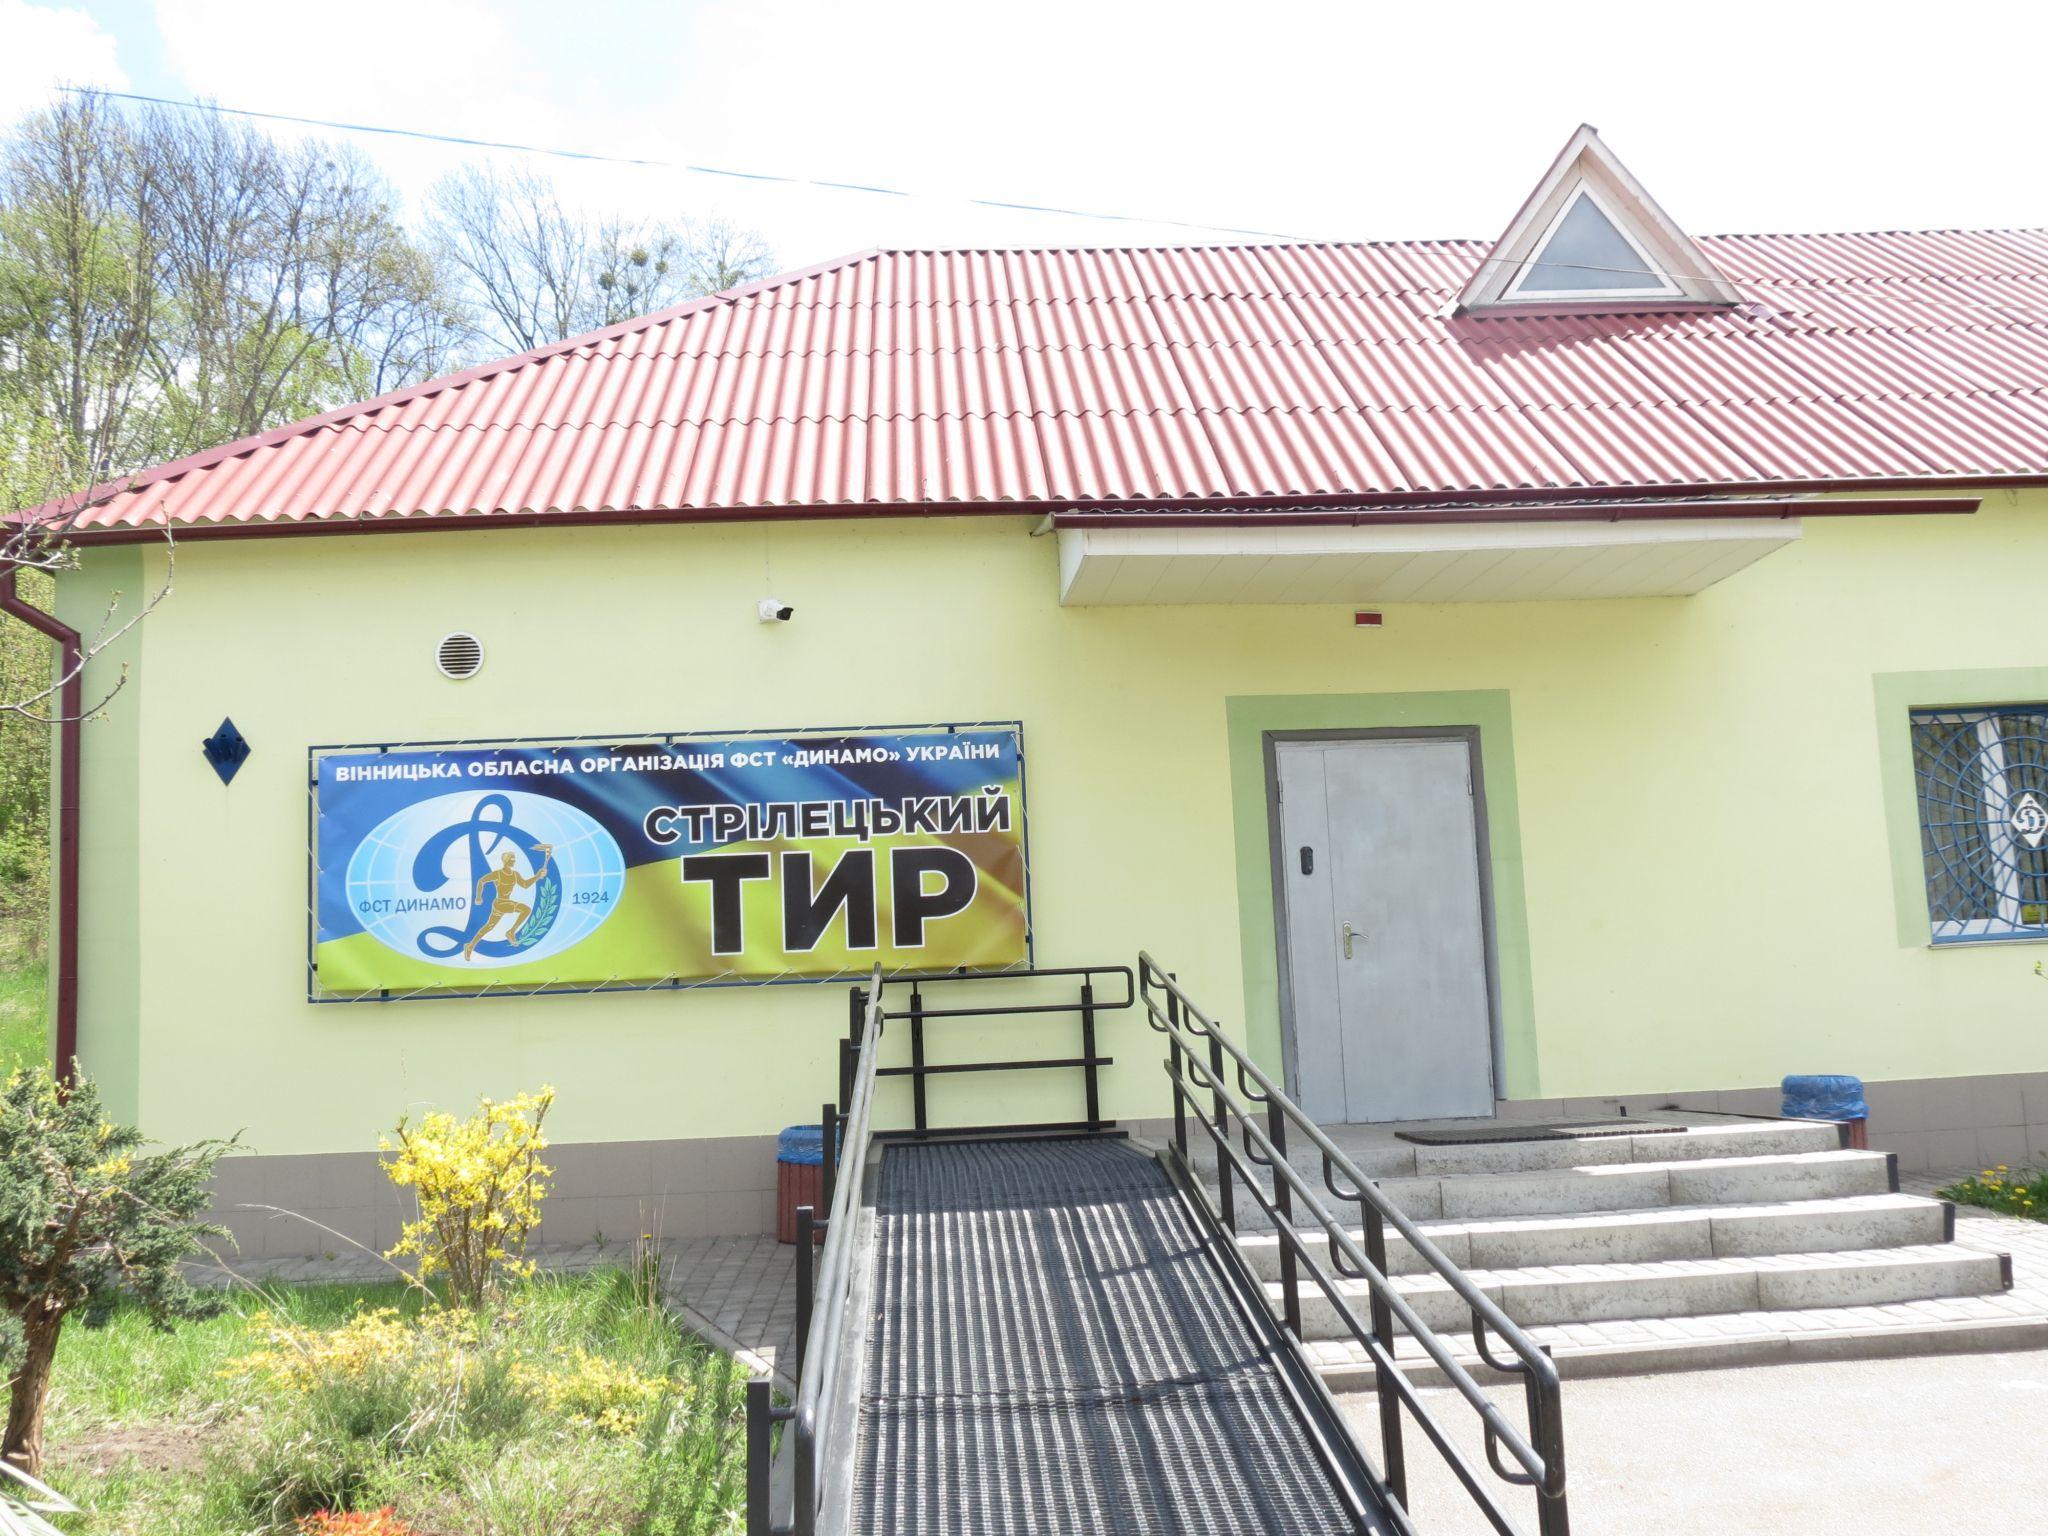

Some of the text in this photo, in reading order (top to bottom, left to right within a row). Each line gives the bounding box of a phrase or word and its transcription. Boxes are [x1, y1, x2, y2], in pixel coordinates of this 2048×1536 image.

[335, 741, 1001, 782] ВІННИЦЬКА ОБЛАСНА ОРГАНІЗАЦІЯ ФСТ «ДИНАМО» УКРАЇНИ
[643, 784, 1012, 846] СТРІЛЕЦЬКИЙ
[358, 896, 467, 915] ФСТ ДИНАМО
[571, 890, 610, 906] 1924
[680, 845, 978, 956] ТИР
